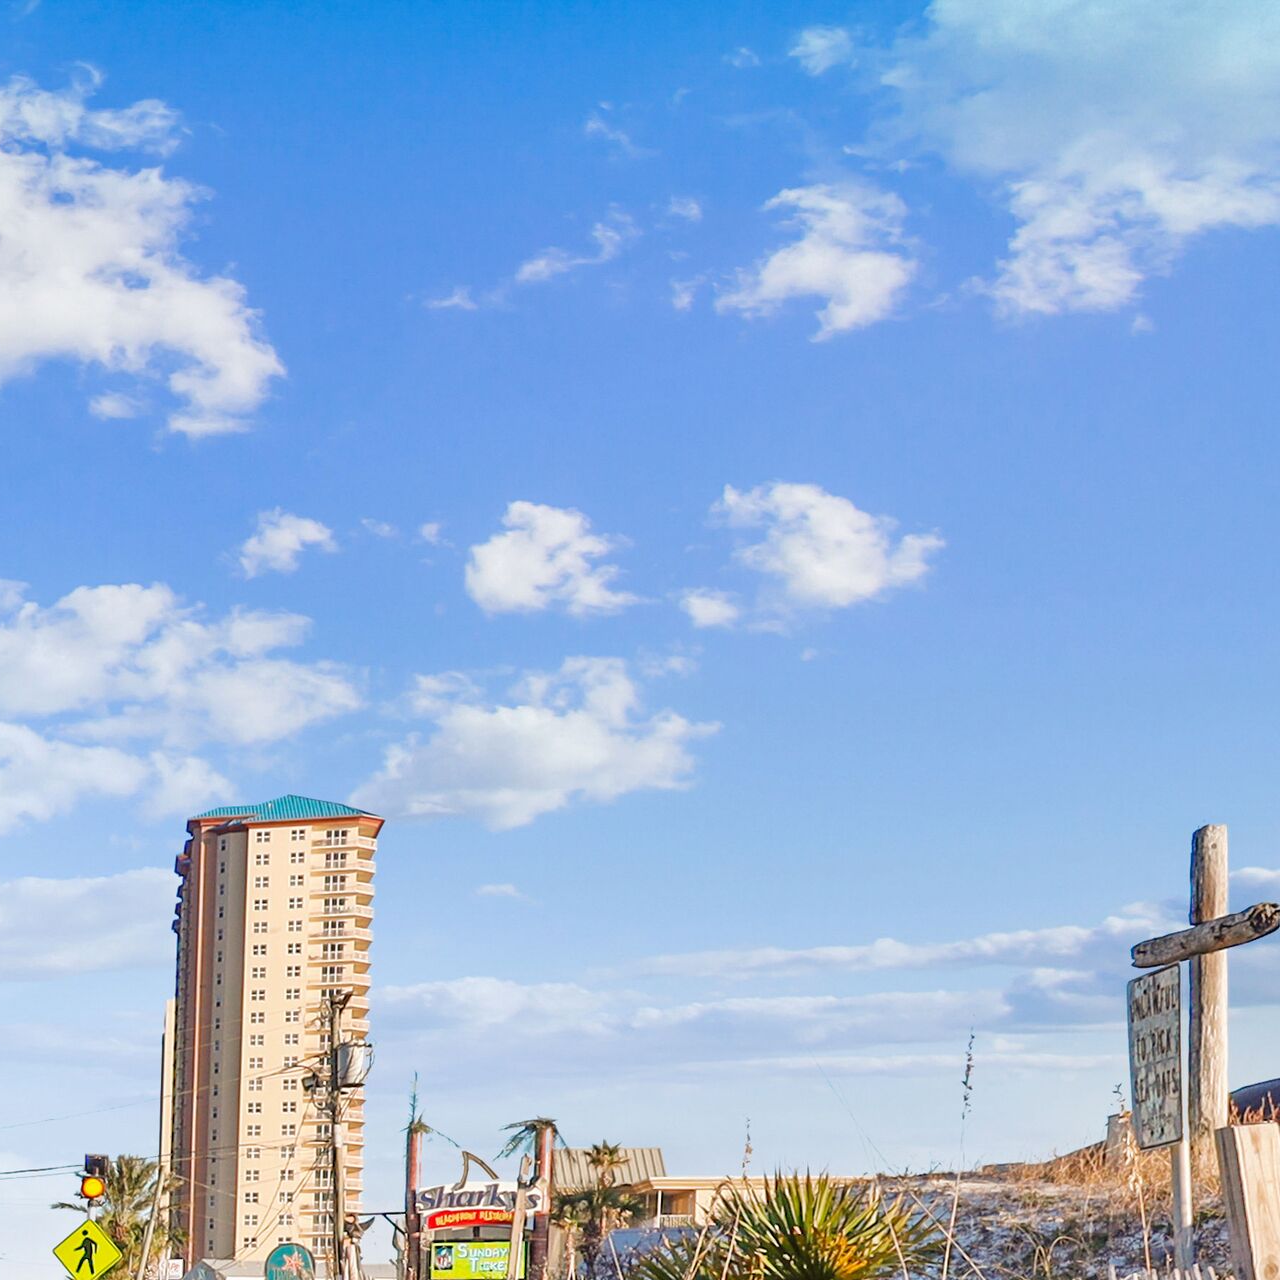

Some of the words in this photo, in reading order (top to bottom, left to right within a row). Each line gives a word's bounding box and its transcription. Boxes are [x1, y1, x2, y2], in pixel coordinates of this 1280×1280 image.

[1130, 984, 1178, 1023] UNLAWFUL
[1136, 1034, 1146, 1063] TO
[1151, 1027, 1173, 1059] PICK
[415, 1183, 542, 1212] Sharkys
[457, 1243, 508, 1258] SUNDAY
[469, 1257, 508, 1272] TICKE
